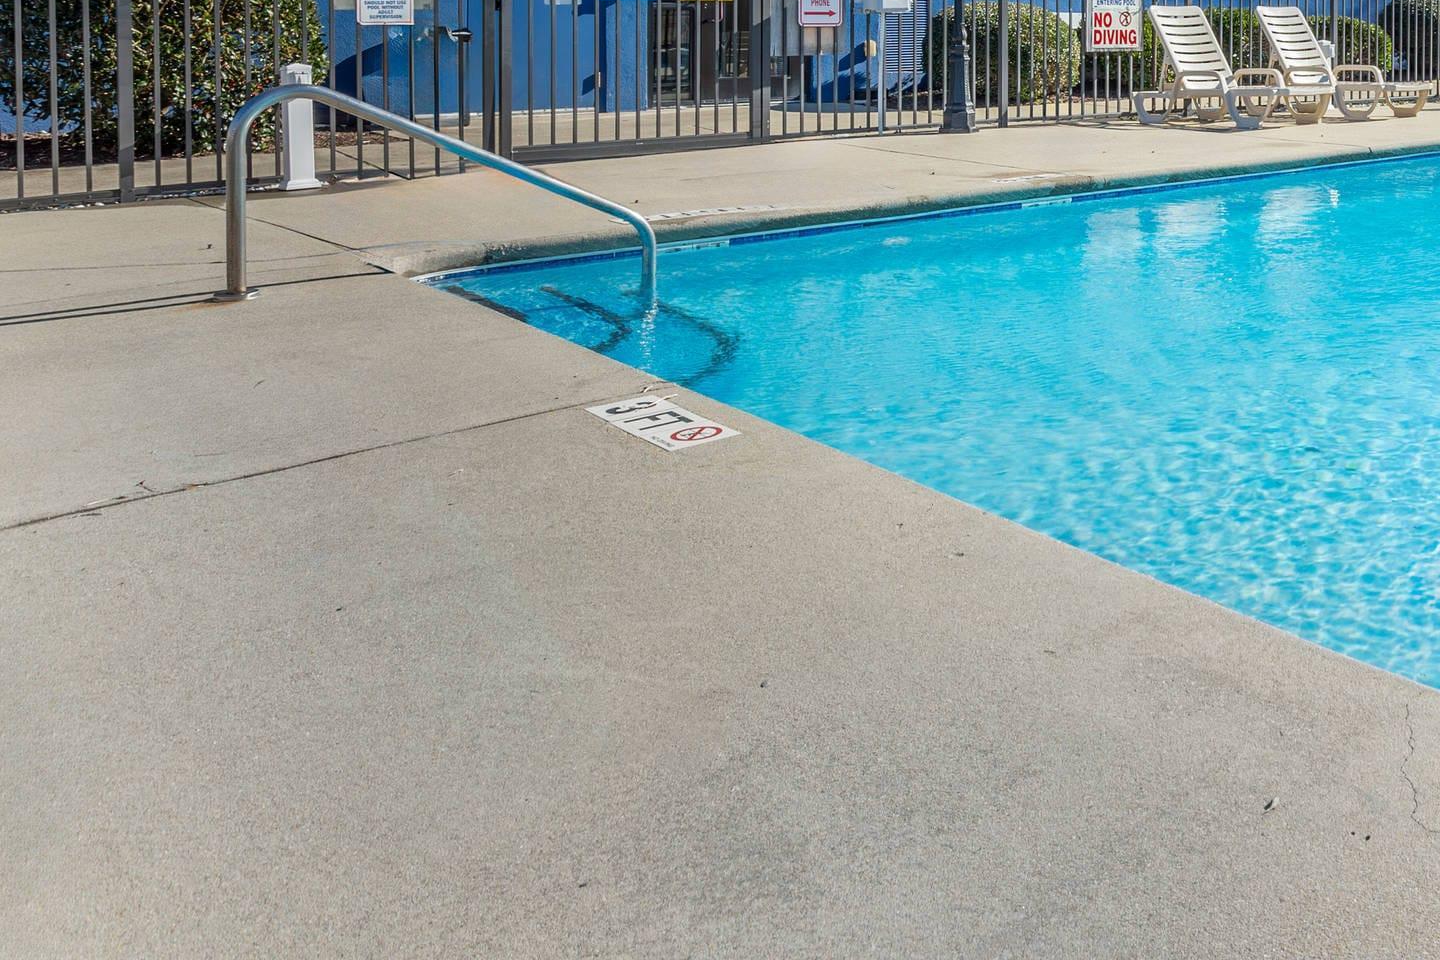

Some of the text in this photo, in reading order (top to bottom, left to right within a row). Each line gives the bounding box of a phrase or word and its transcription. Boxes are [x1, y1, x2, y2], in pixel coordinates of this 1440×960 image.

[1093, 12, 1112, 28] NO
[1093, 29, 1137, 45] DIVING
[605, 401, 694, 431] 3 FT
